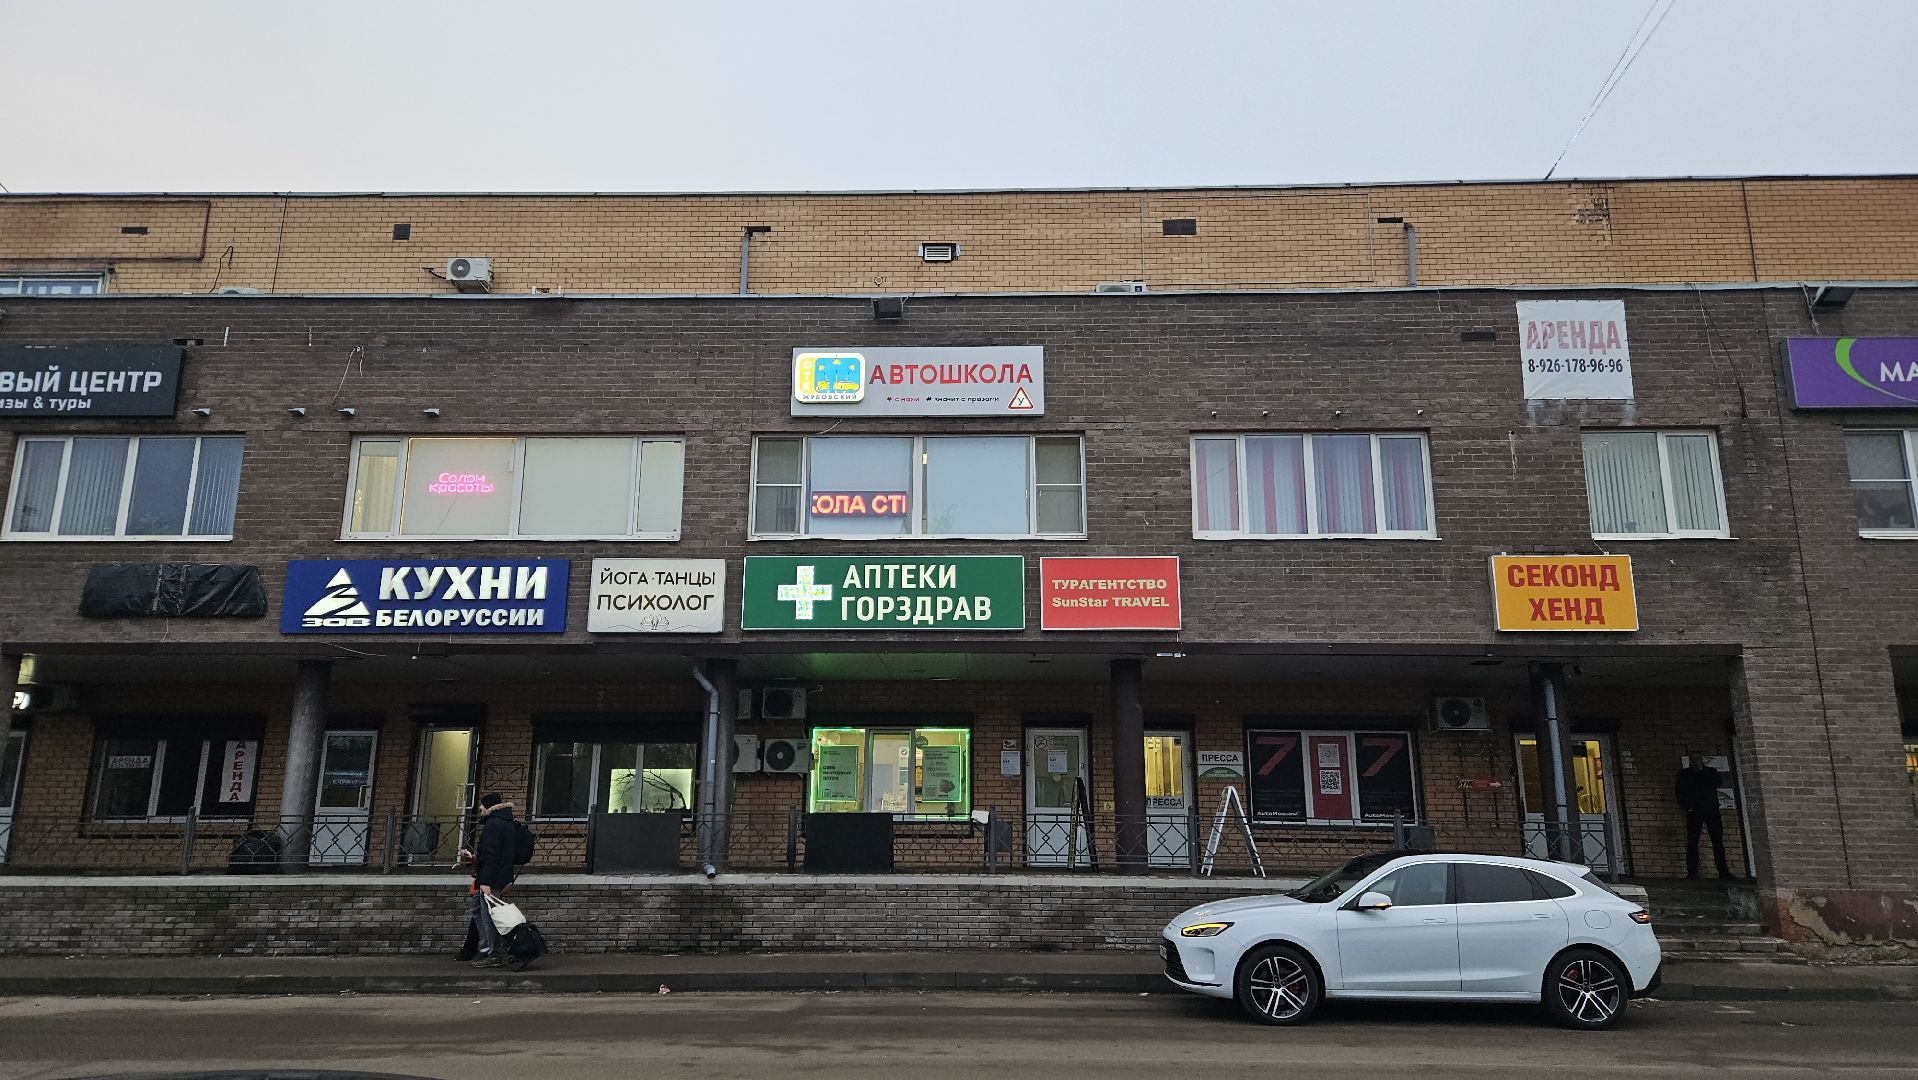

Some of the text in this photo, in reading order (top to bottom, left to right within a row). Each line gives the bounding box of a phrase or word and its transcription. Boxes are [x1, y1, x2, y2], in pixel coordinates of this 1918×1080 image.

[1527, 320, 1621, 355] АРЕНДА
[869, 364, 1034, 385] АВТОШКОЛА
[1528, 358, 1623, 373] 8-926-178-96-96
[68, 371, 162, 396] ЦЕНТР
[33, 396, 44, 409] &
[49, 398, 91, 411] туры
[438, 472, 486, 484] Салон
[429, 483, 494, 494] красоты
[379, 566, 549, 600] КУХНИ
[600, 568, 716, 587] ЙОГА ТАНЦЫ
[842, 565, 957, 589] АПТЕКИ
[1052, 579, 1167, 590] ТУРАГЕНТСТВО
[1507, 564, 1620, 591] СЕКОНД
[597, 594, 715, 611] ПСИХОЛОГ
[841, 596, 992, 625] ГОРЗДРАВ
[1052, 597, 1170, 607] SunStar TRAVEL
[1528, 598, 1606, 625] ХЕНД
[376, 609, 544, 626] БЕЛОРУССИИ
[1201, 754, 1239, 762] ПРЕССА
[229, 740, 246, 801] АРЕНДА
